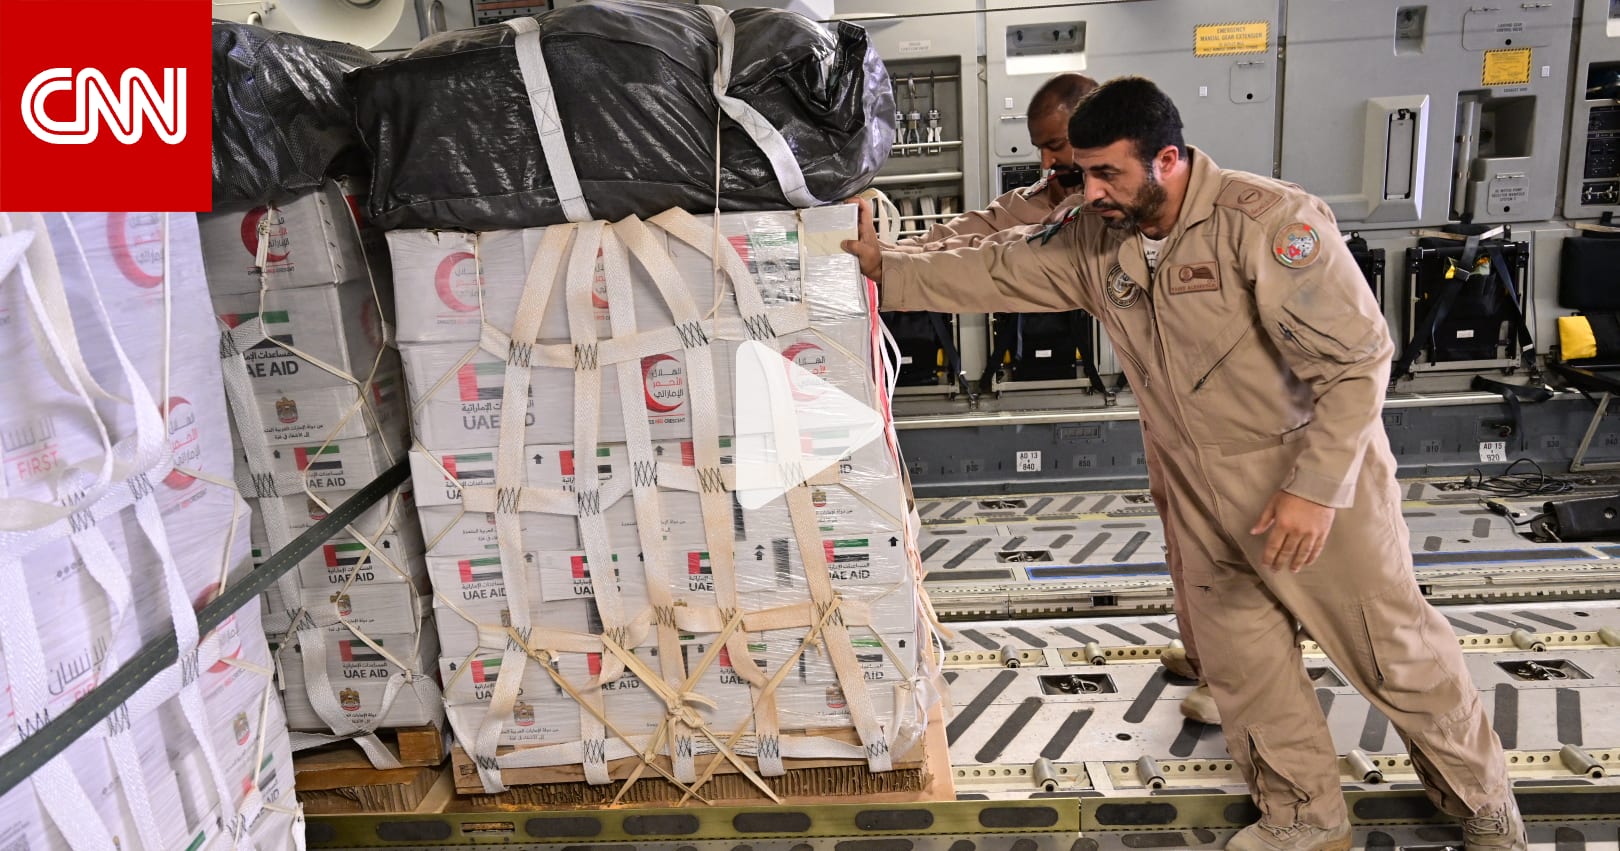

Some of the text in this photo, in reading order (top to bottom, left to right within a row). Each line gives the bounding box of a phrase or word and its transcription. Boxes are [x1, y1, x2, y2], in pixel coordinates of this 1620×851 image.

[246, 360, 299, 378] AE AID
[463, 414, 501, 430] UAE
[17, 450, 59, 480] FIRST
[840, 464, 853, 474] ID
[306, 477, 346, 489] AE AID
[446, 489, 462, 500] UA
[355, 572, 375, 582] AID
[829, 569, 870, 580] AE AID
[688, 582, 713, 592] UAE
[463, 588, 488, 601] UAE
[343, 668, 389, 679] UAE AID
[863, 671, 885, 680] AID
[601, 679, 640, 690] AE AID
[475, 690, 492, 700] UA
